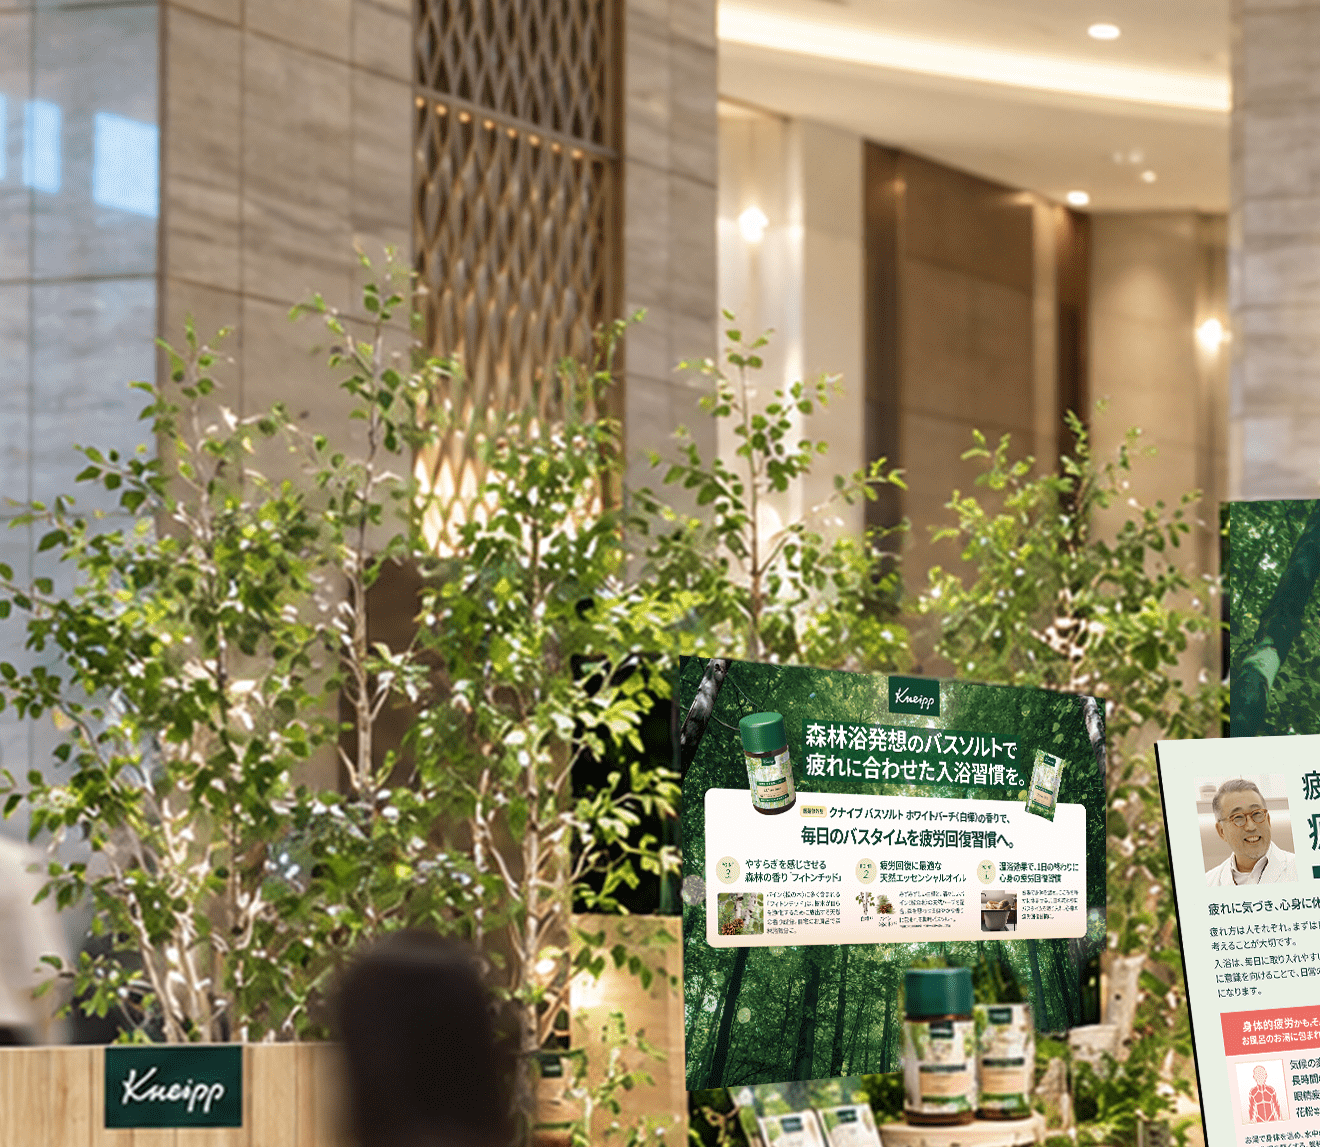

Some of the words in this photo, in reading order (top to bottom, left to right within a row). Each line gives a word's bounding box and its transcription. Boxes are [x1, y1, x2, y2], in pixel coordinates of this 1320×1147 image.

[895, 687, 935, 711] Kneipp
[805, 723, 1018, 761] 森林浴発想のバスソルトで
[805, 753, 1026, 788] 疲れに合わせた入浴習慣を。
[829, 807, 863, 819] クナイプ
[865, 808, 903, 820] バスソルト
[801, 826, 1014, 849] 毎日のバスタイムを疲労回復習慣へ。
[745, 859, 827, 870] やすらぎを感じさせる
[880, 860, 942, 871] 疲労回復に最適な
[880, 873, 967, 883] 天然エッセンシャルオイル
[1211, 935, 1299, 951] 考えることが大切です。
[1218, 986, 1263, 998] になります。
[121, 1066, 225, 1113] Kneipp
